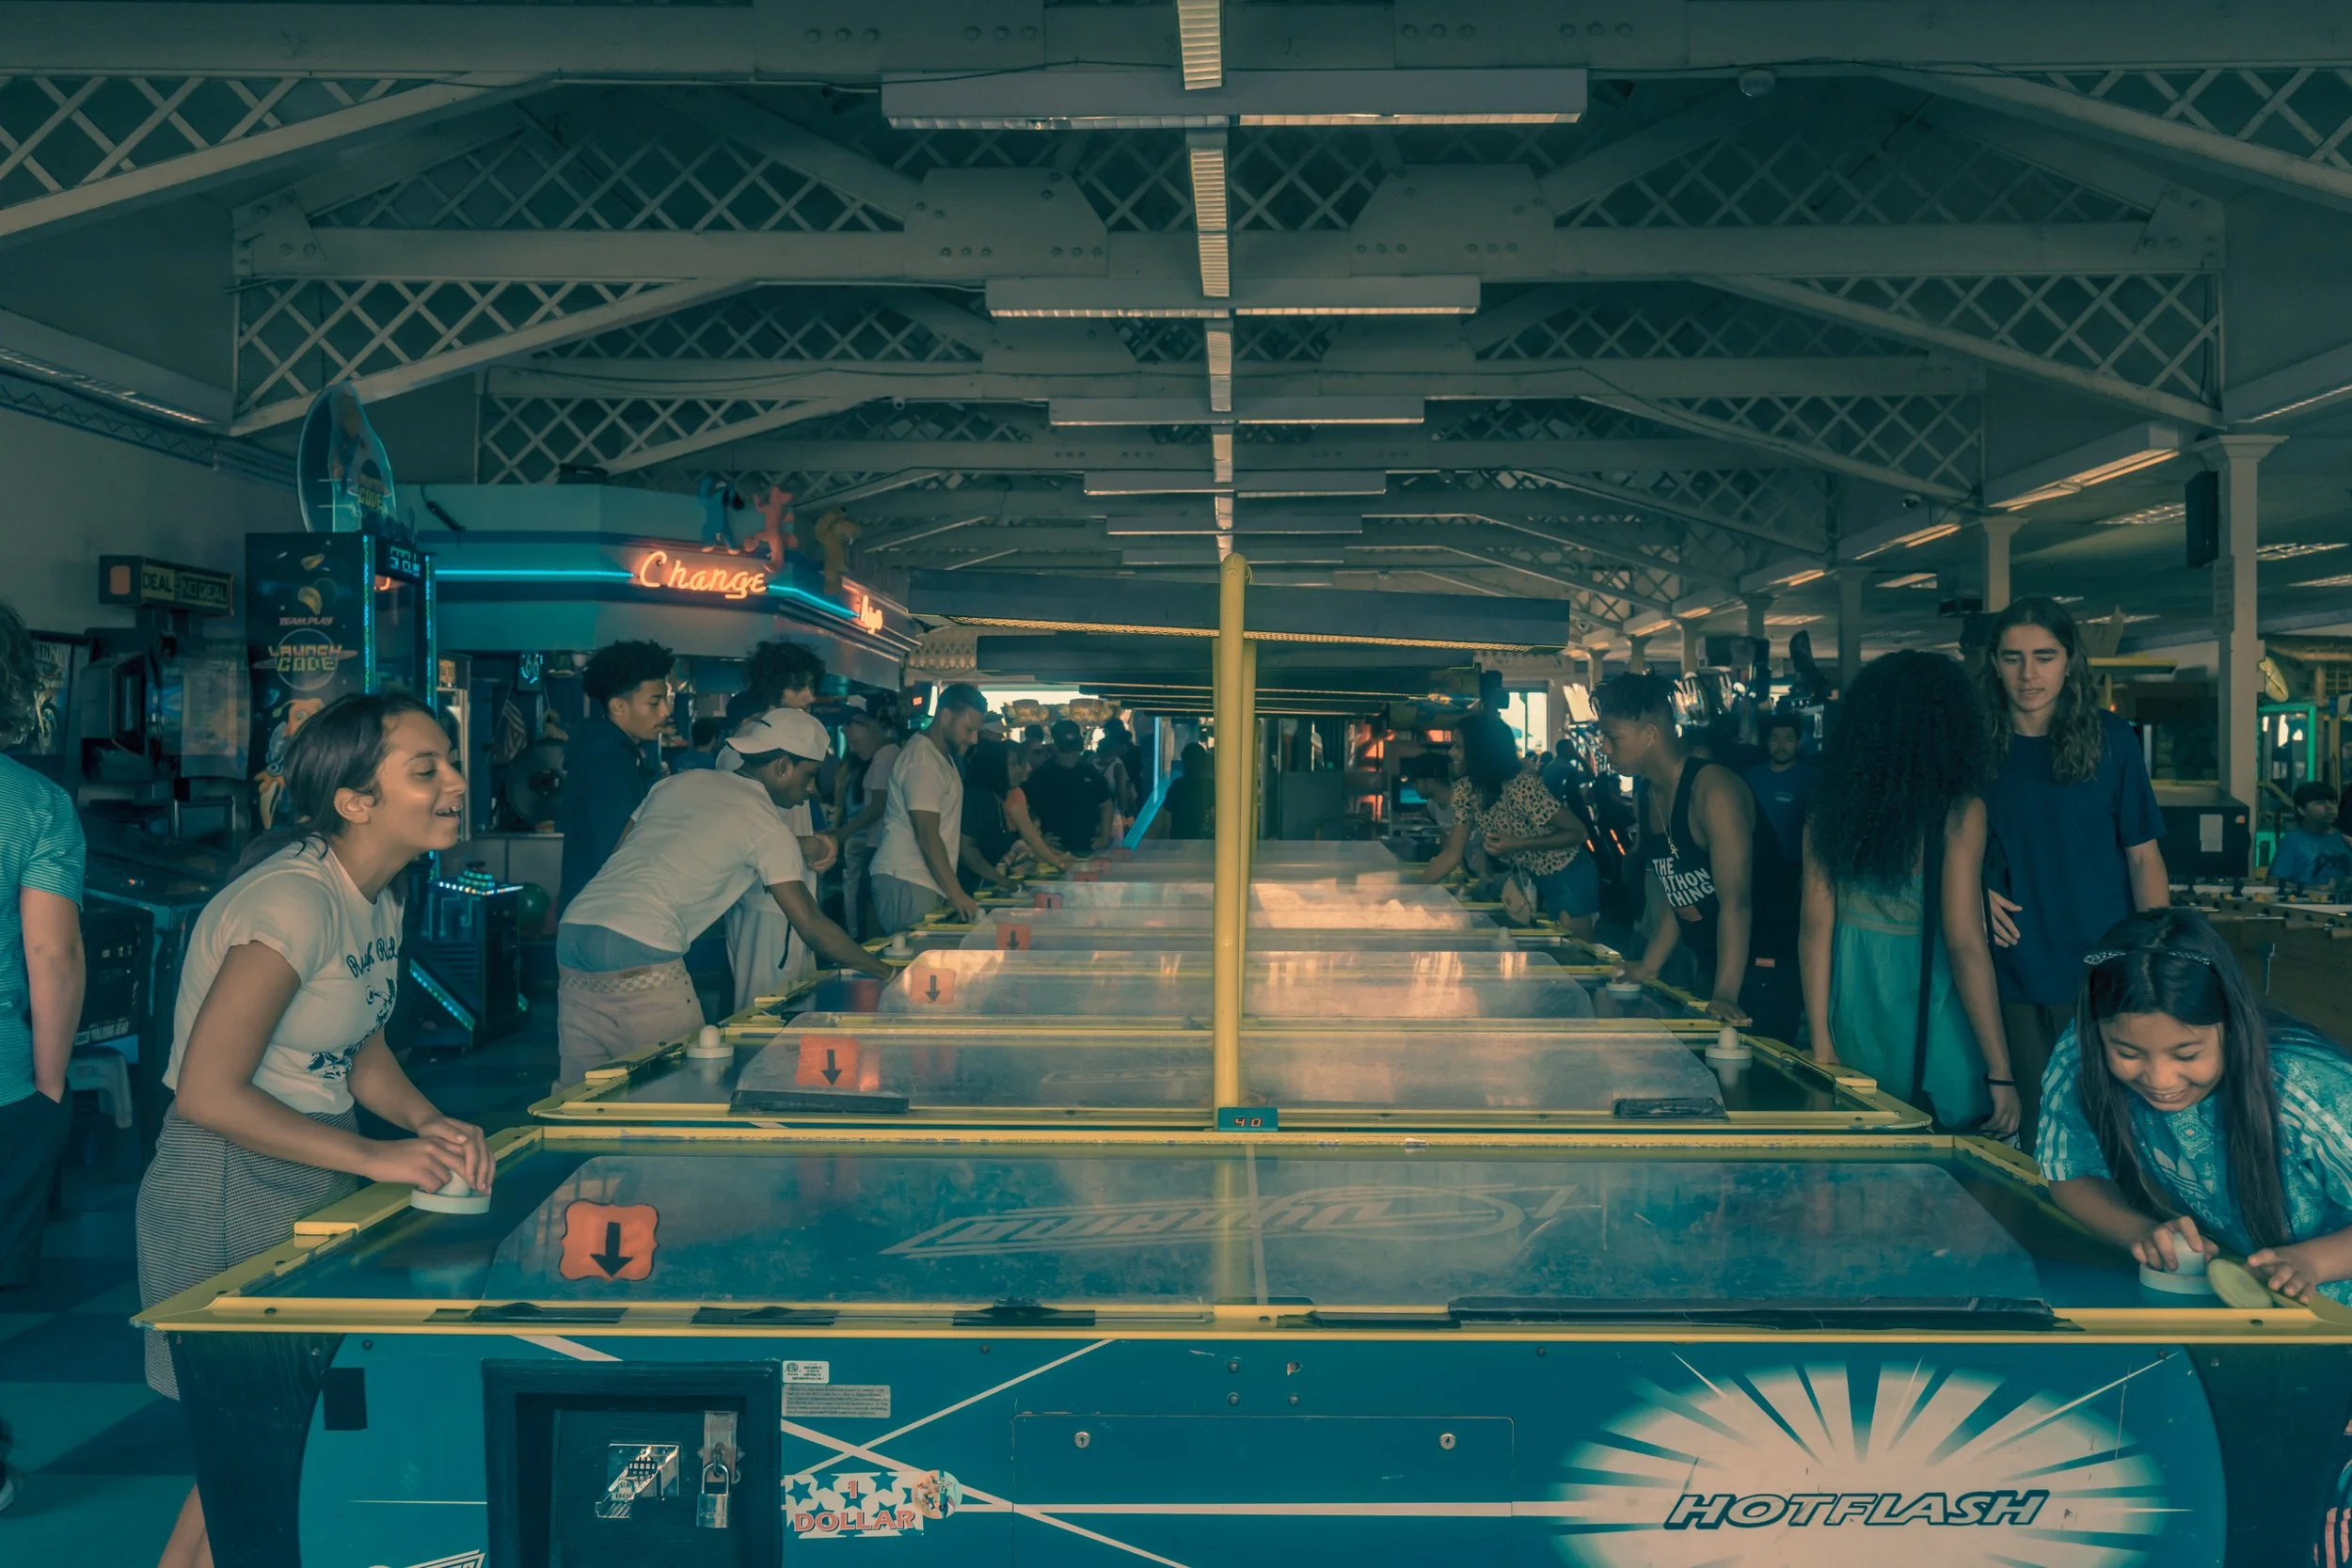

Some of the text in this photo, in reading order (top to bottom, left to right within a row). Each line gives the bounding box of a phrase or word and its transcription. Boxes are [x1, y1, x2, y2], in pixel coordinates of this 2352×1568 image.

[640, 550, 768, 600] Change
[142, 572, 173, 594] DEAL
[183, 577, 199, 600] NO
[199, 581, 227, 603] DEAL
[278, 616, 334, 626] TEAM PLAY
[267, 644, 342, 657] LAUNCH
[276, 656, 337, 673] CODE
[1652, 857, 1675, 877] THE
[1658, 867, 1711, 894] ATHON
[1666, 881, 1716, 908] THING
[847, 1480, 860, 1499] 1
[794, 1510, 916, 1533] DOLLAR
[1662, 1489, 2051, 1531] HOTFLASH
